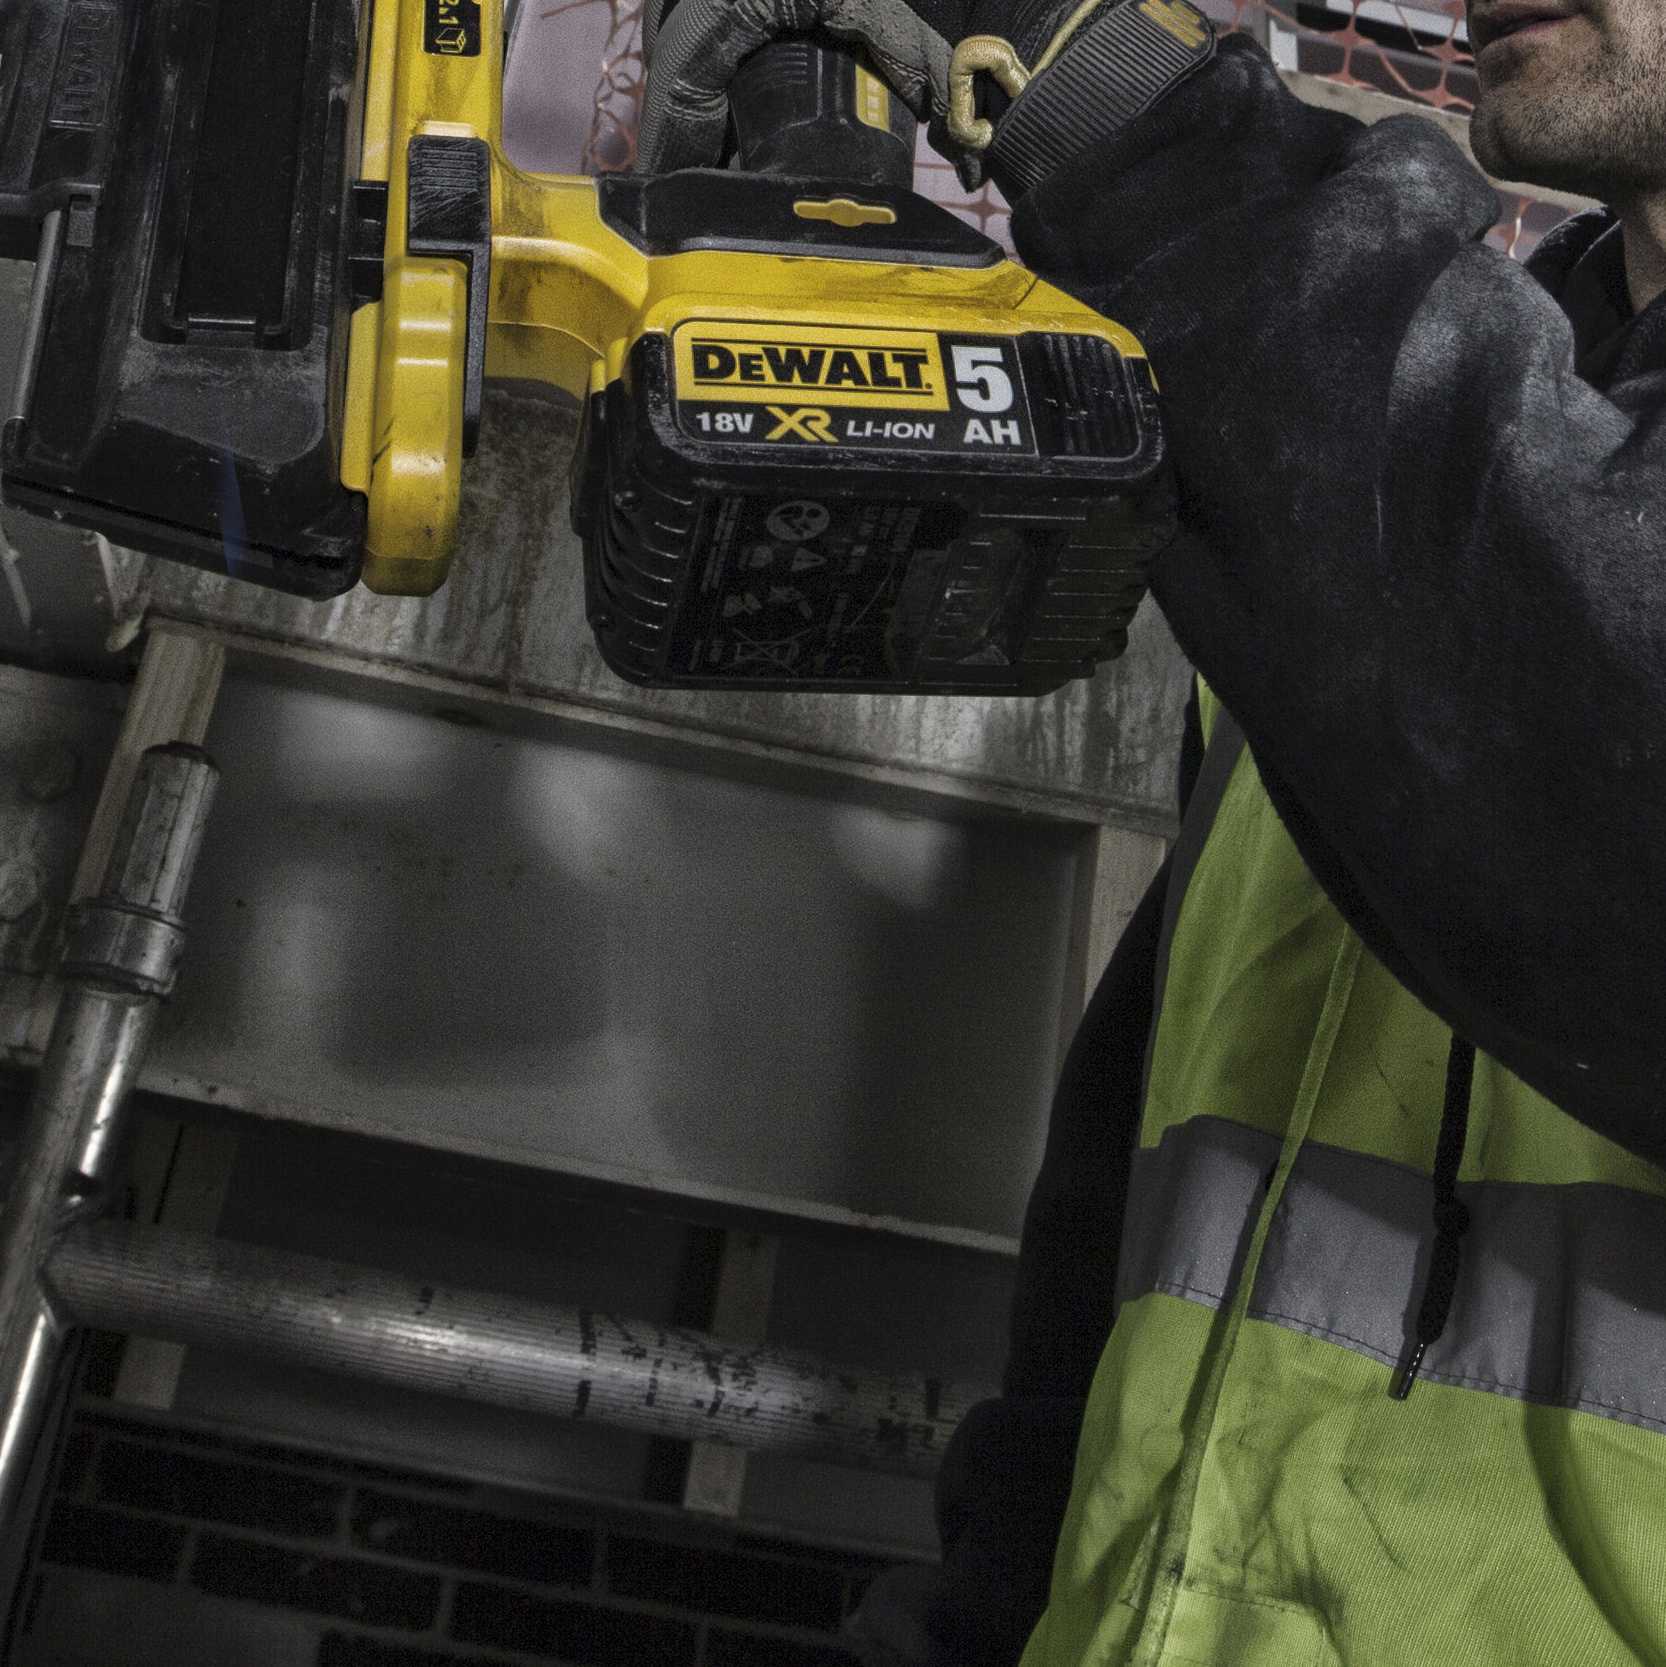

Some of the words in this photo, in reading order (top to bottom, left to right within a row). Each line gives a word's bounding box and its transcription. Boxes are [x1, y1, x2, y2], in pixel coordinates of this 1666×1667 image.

[439, 16, 460, 25] 1
[692, 344, 929, 390] DEWALT
[951, 345, 1015, 414] 5
[696, 411, 754, 434] 18V
[764, 406, 839, 443] XR
[846, 419, 936, 440] LI-ION
[963, 418, 1022, 446] AH
